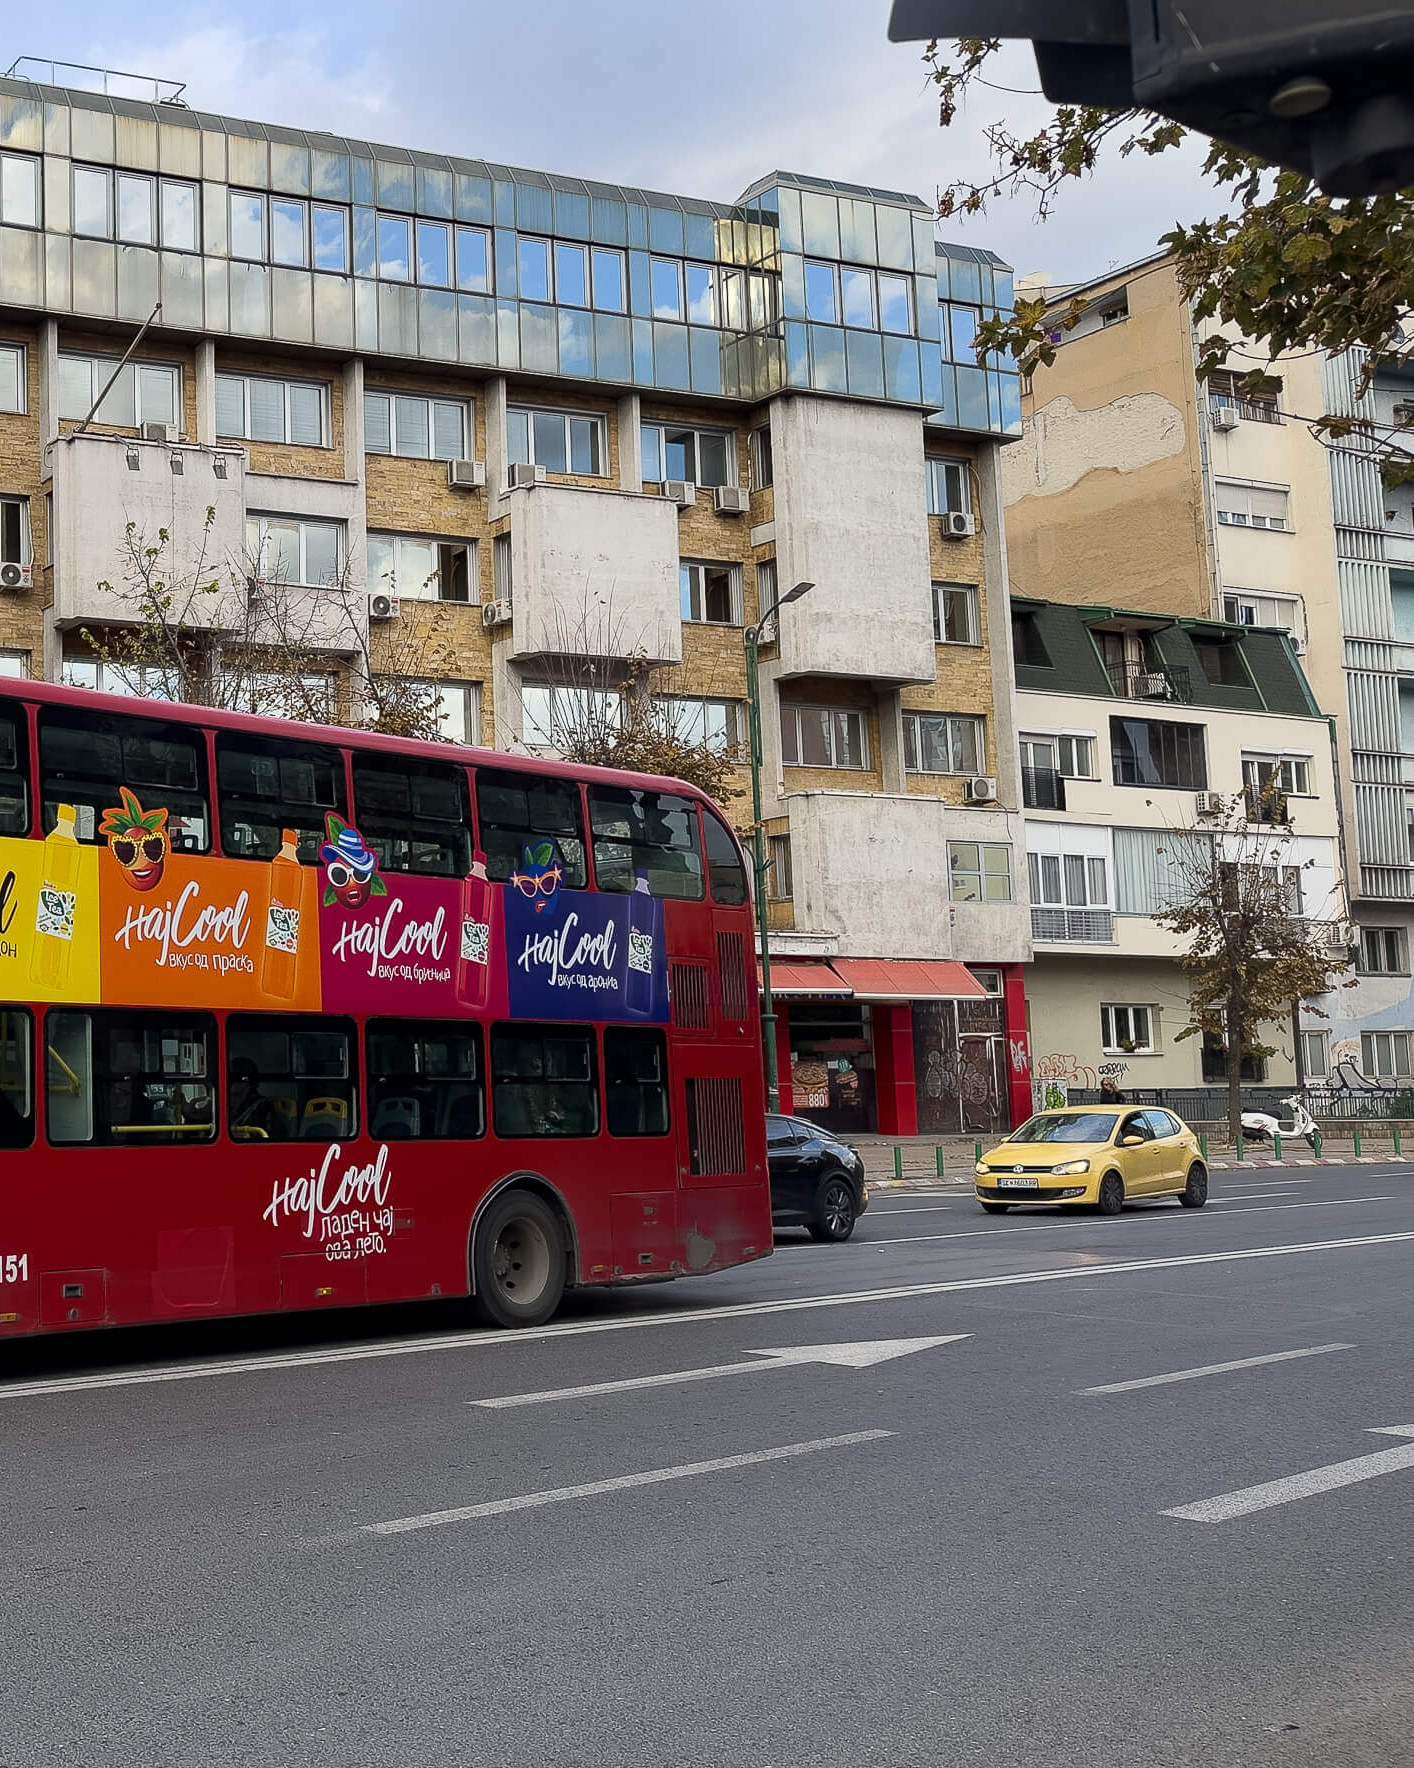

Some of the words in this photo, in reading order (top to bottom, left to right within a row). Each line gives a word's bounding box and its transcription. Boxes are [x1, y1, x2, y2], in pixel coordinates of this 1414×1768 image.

[212, 953, 254, 976] праска
[319, 1210, 370, 1242] ладен
[373, 1205, 393, 1236] чај
[326, 1240, 351, 1261] ова
